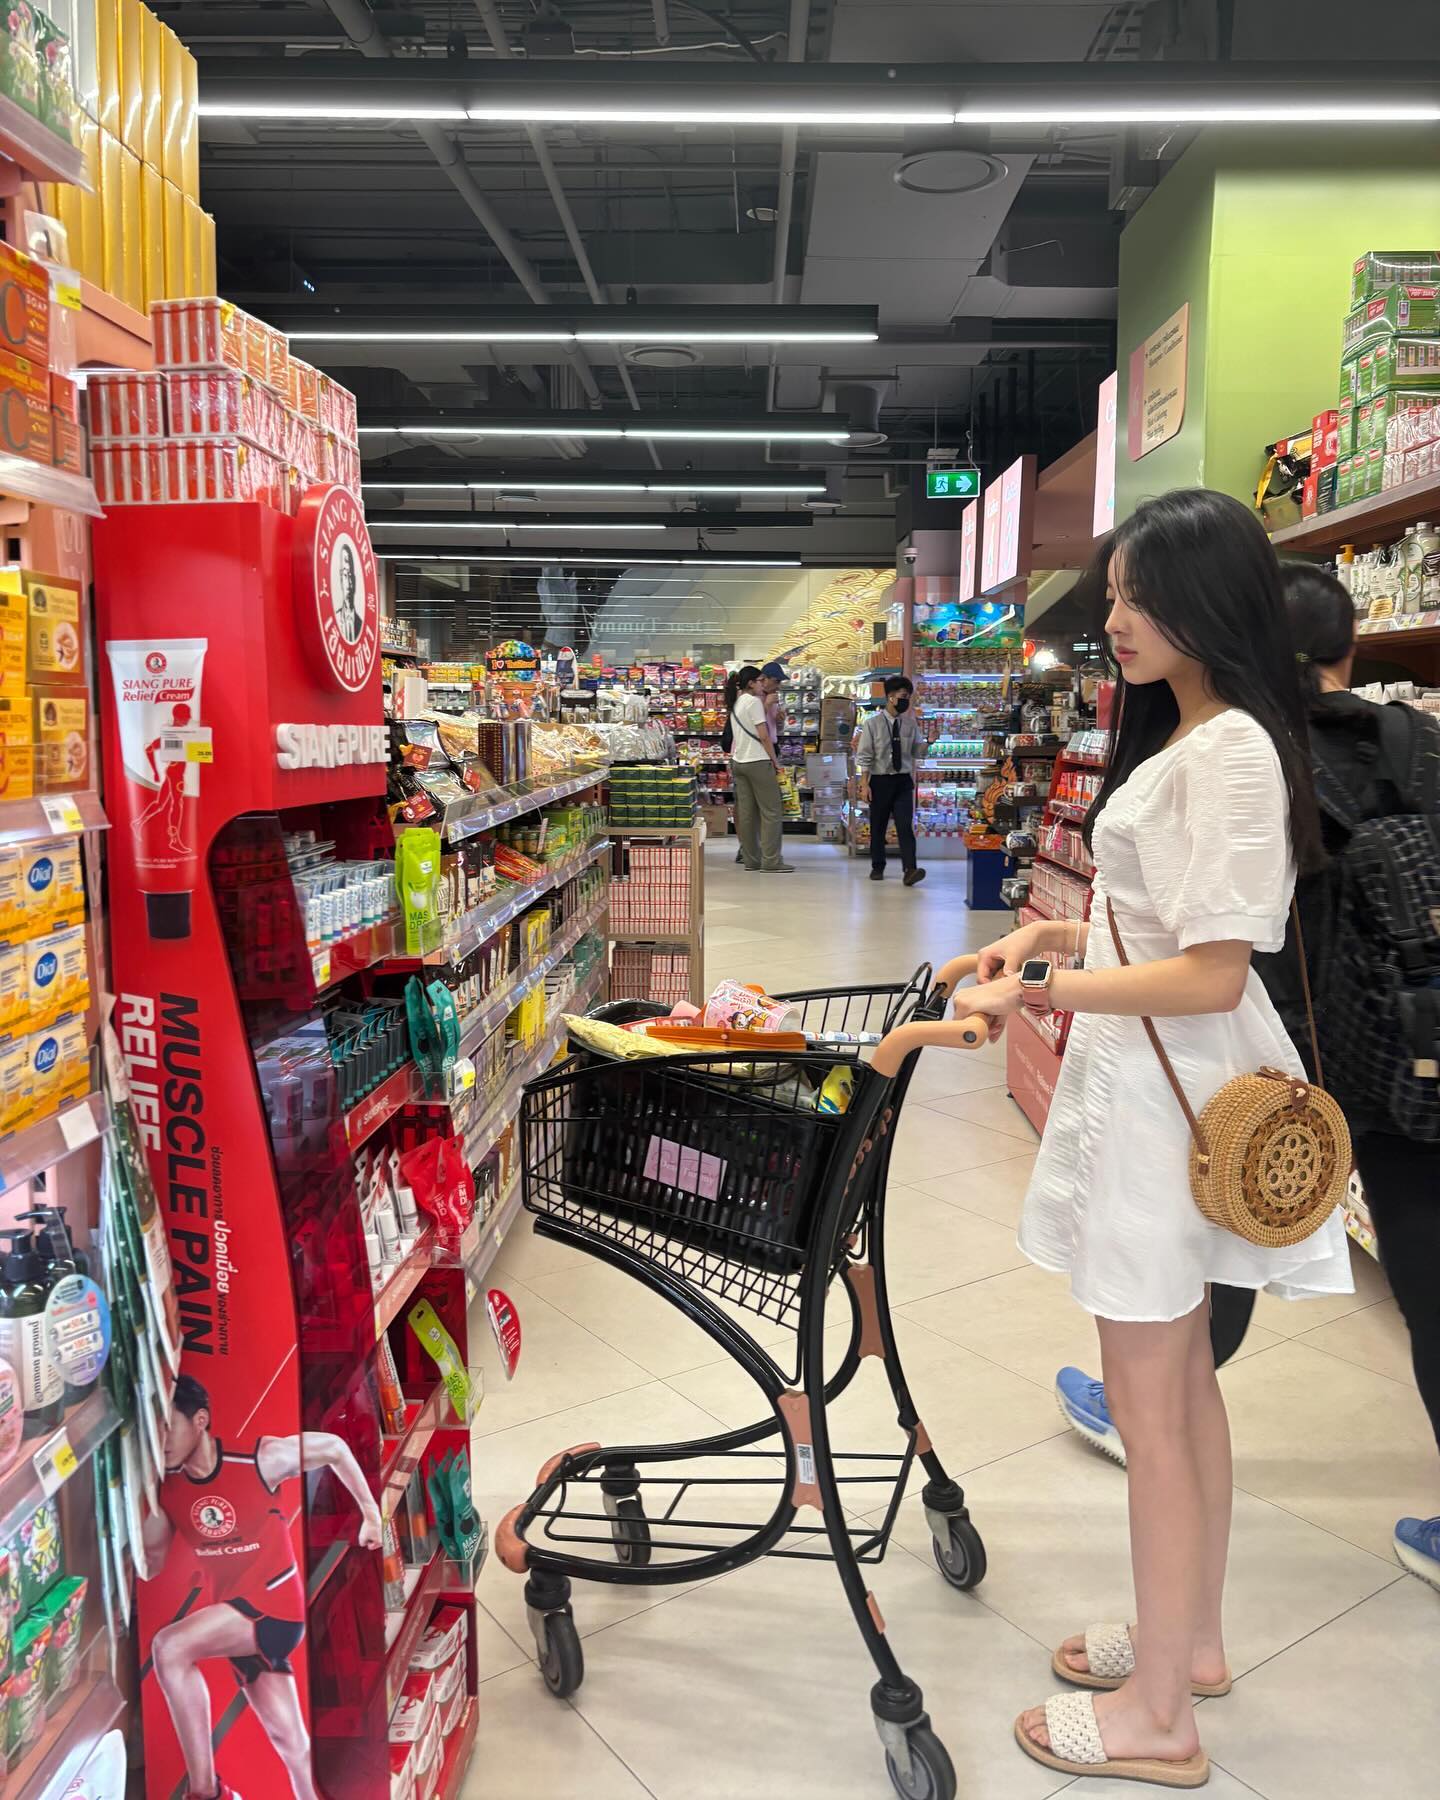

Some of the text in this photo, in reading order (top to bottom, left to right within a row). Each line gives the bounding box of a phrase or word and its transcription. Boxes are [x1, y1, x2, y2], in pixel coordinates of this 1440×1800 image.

[320, 499, 373, 577] SIANG PURE
[122, 678, 193, 690] SIANG PURE
[123, 690, 190, 702] Relief Cream
[31, 865, 52, 884] Dial
[37, 958, 57, 980] Dial
[37, 1044, 57, 1067] Dial
[120, 992, 162, 1151] RELIEF
[161, 992, 214, 1355] MUSCLE PAIN
[224, 1543, 260, 1555] Cream
